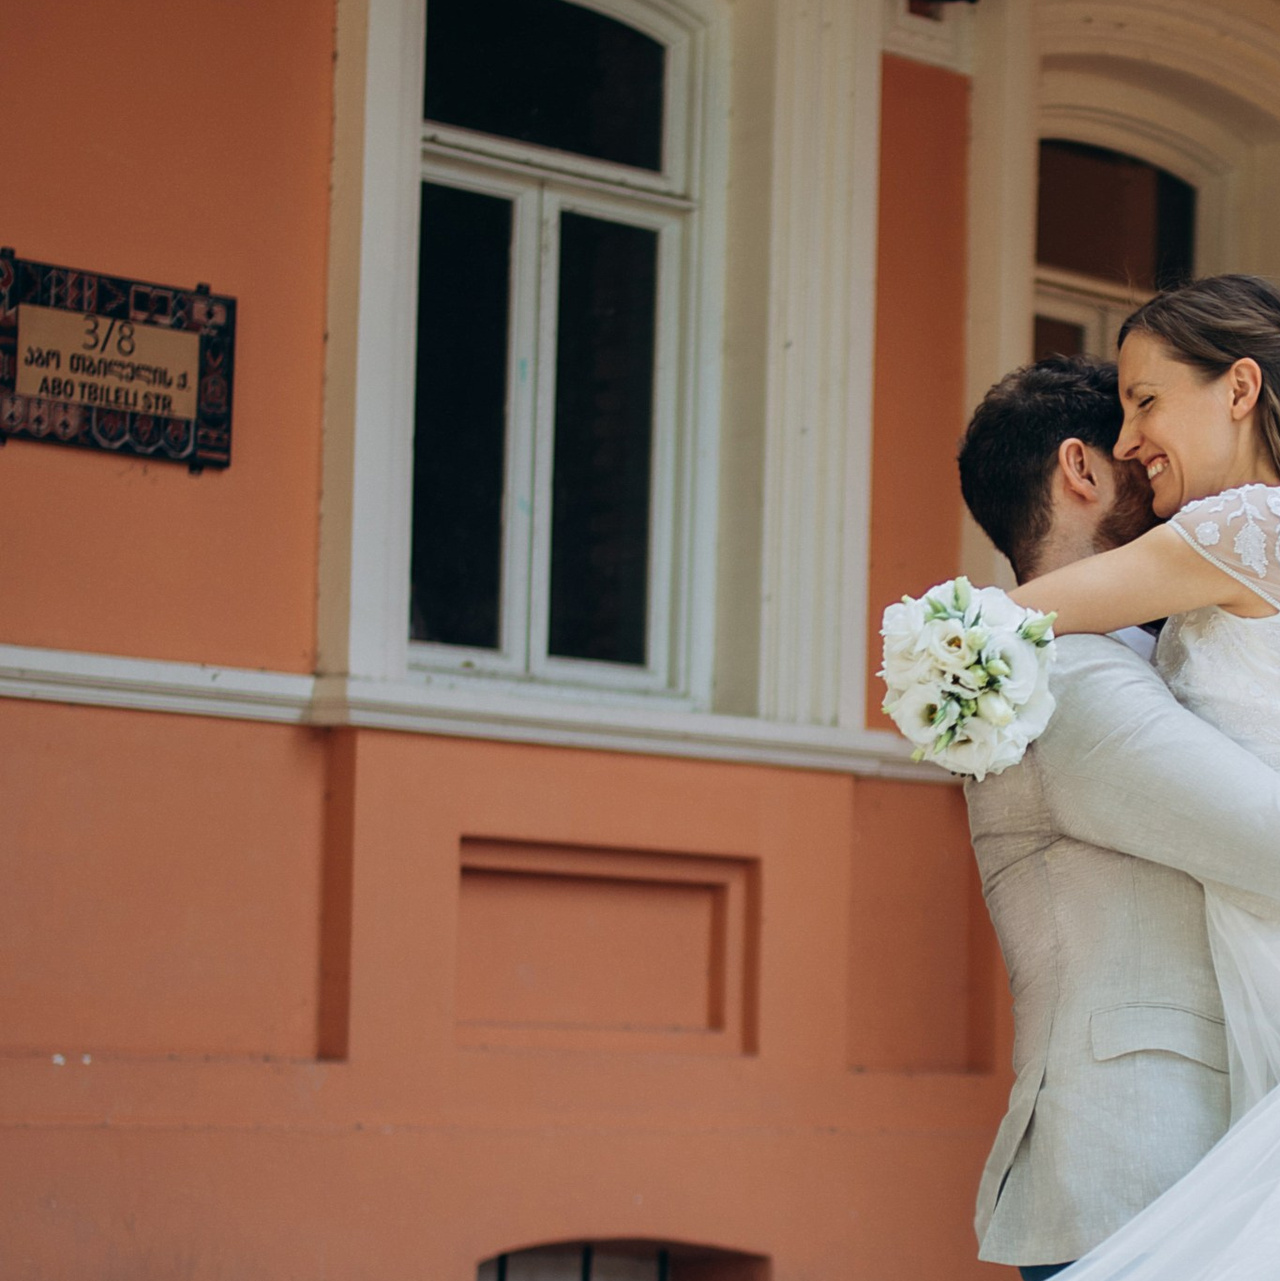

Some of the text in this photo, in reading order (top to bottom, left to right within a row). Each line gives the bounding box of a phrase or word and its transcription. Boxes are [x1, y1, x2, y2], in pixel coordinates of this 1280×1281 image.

[82, 314, 135, 356] 3/8
[39, 376, 74, 398] ABO
[79, 381, 138, 407] TBILELI
